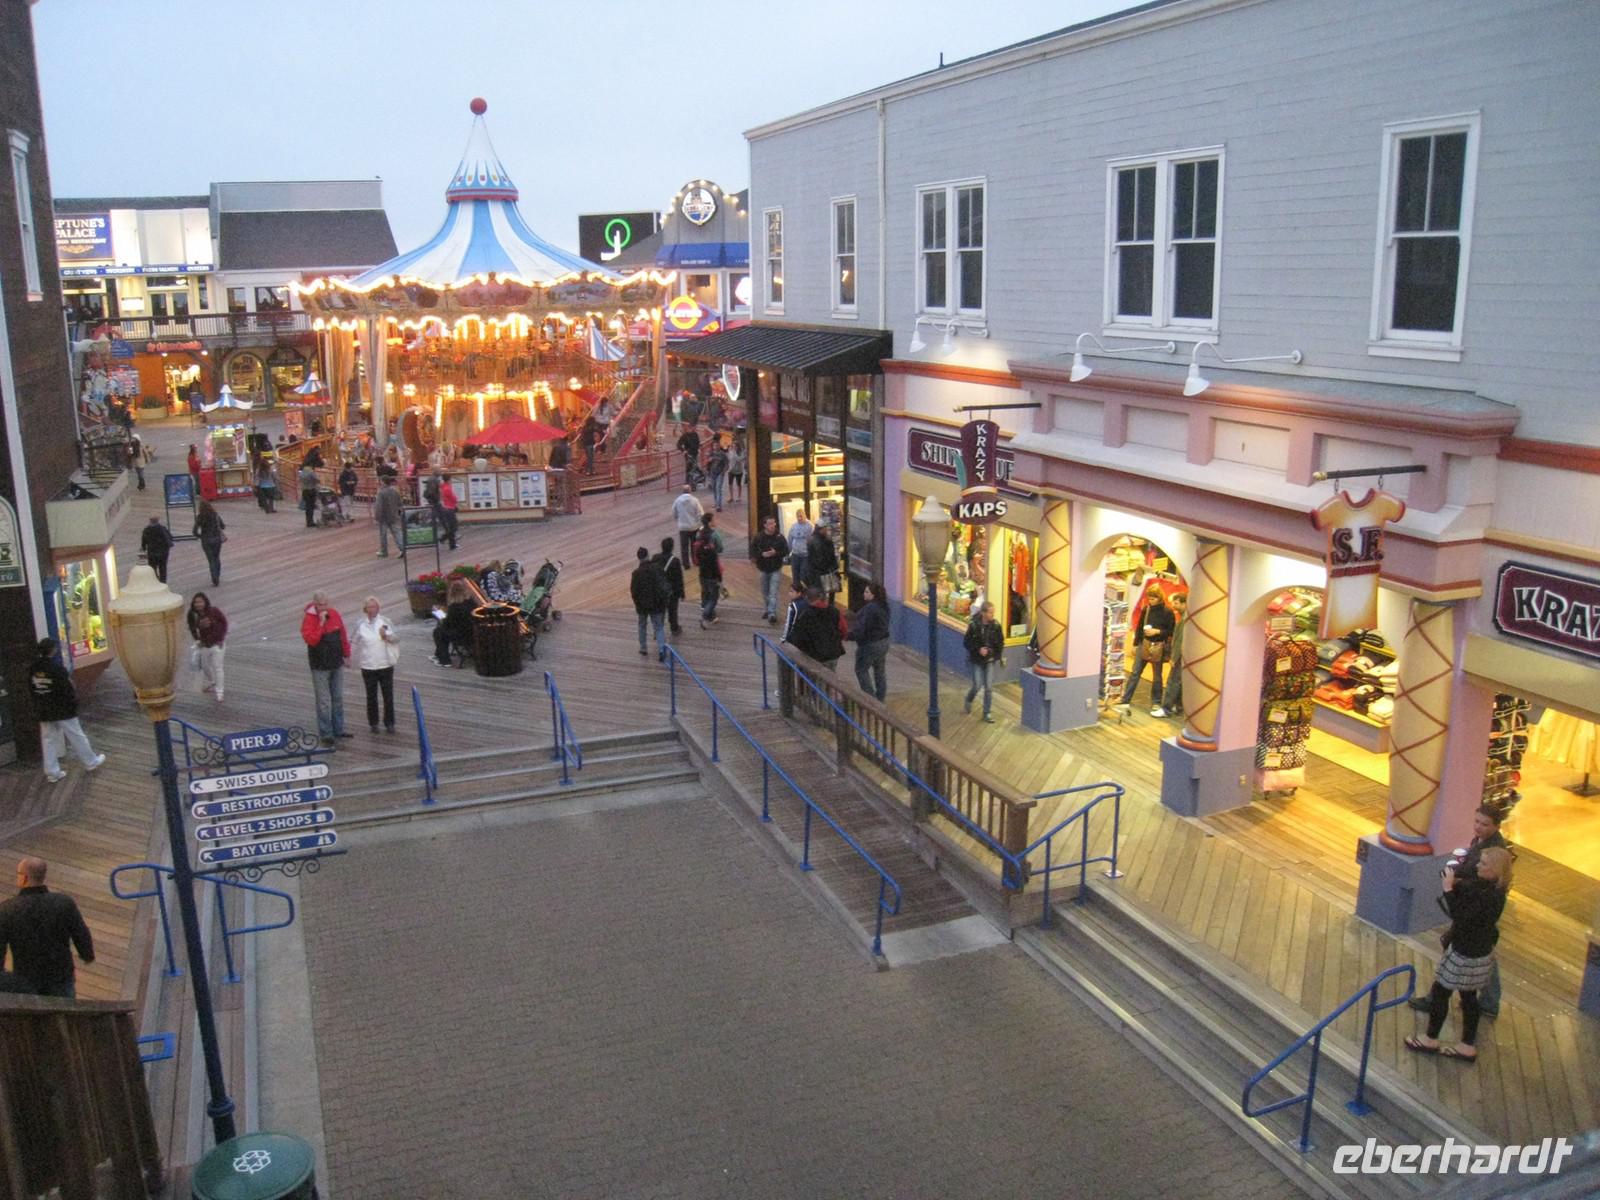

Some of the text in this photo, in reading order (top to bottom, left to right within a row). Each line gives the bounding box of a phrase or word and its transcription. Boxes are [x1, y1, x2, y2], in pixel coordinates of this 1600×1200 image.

[975, 423, 988, 482] KRAZY
[959, 501, 1007, 518] KAPS
[1331, 526, 1384, 565] S.F.
[231, 733, 281, 751] PIER 39
[216, 770, 298, 789] SWISS LOUIS
[222, 793, 301, 813] RESTROOMS
[215, 815, 312, 837] LEVEL 2 SHOPS
[232, 839, 300, 858] BAY VIEWS
